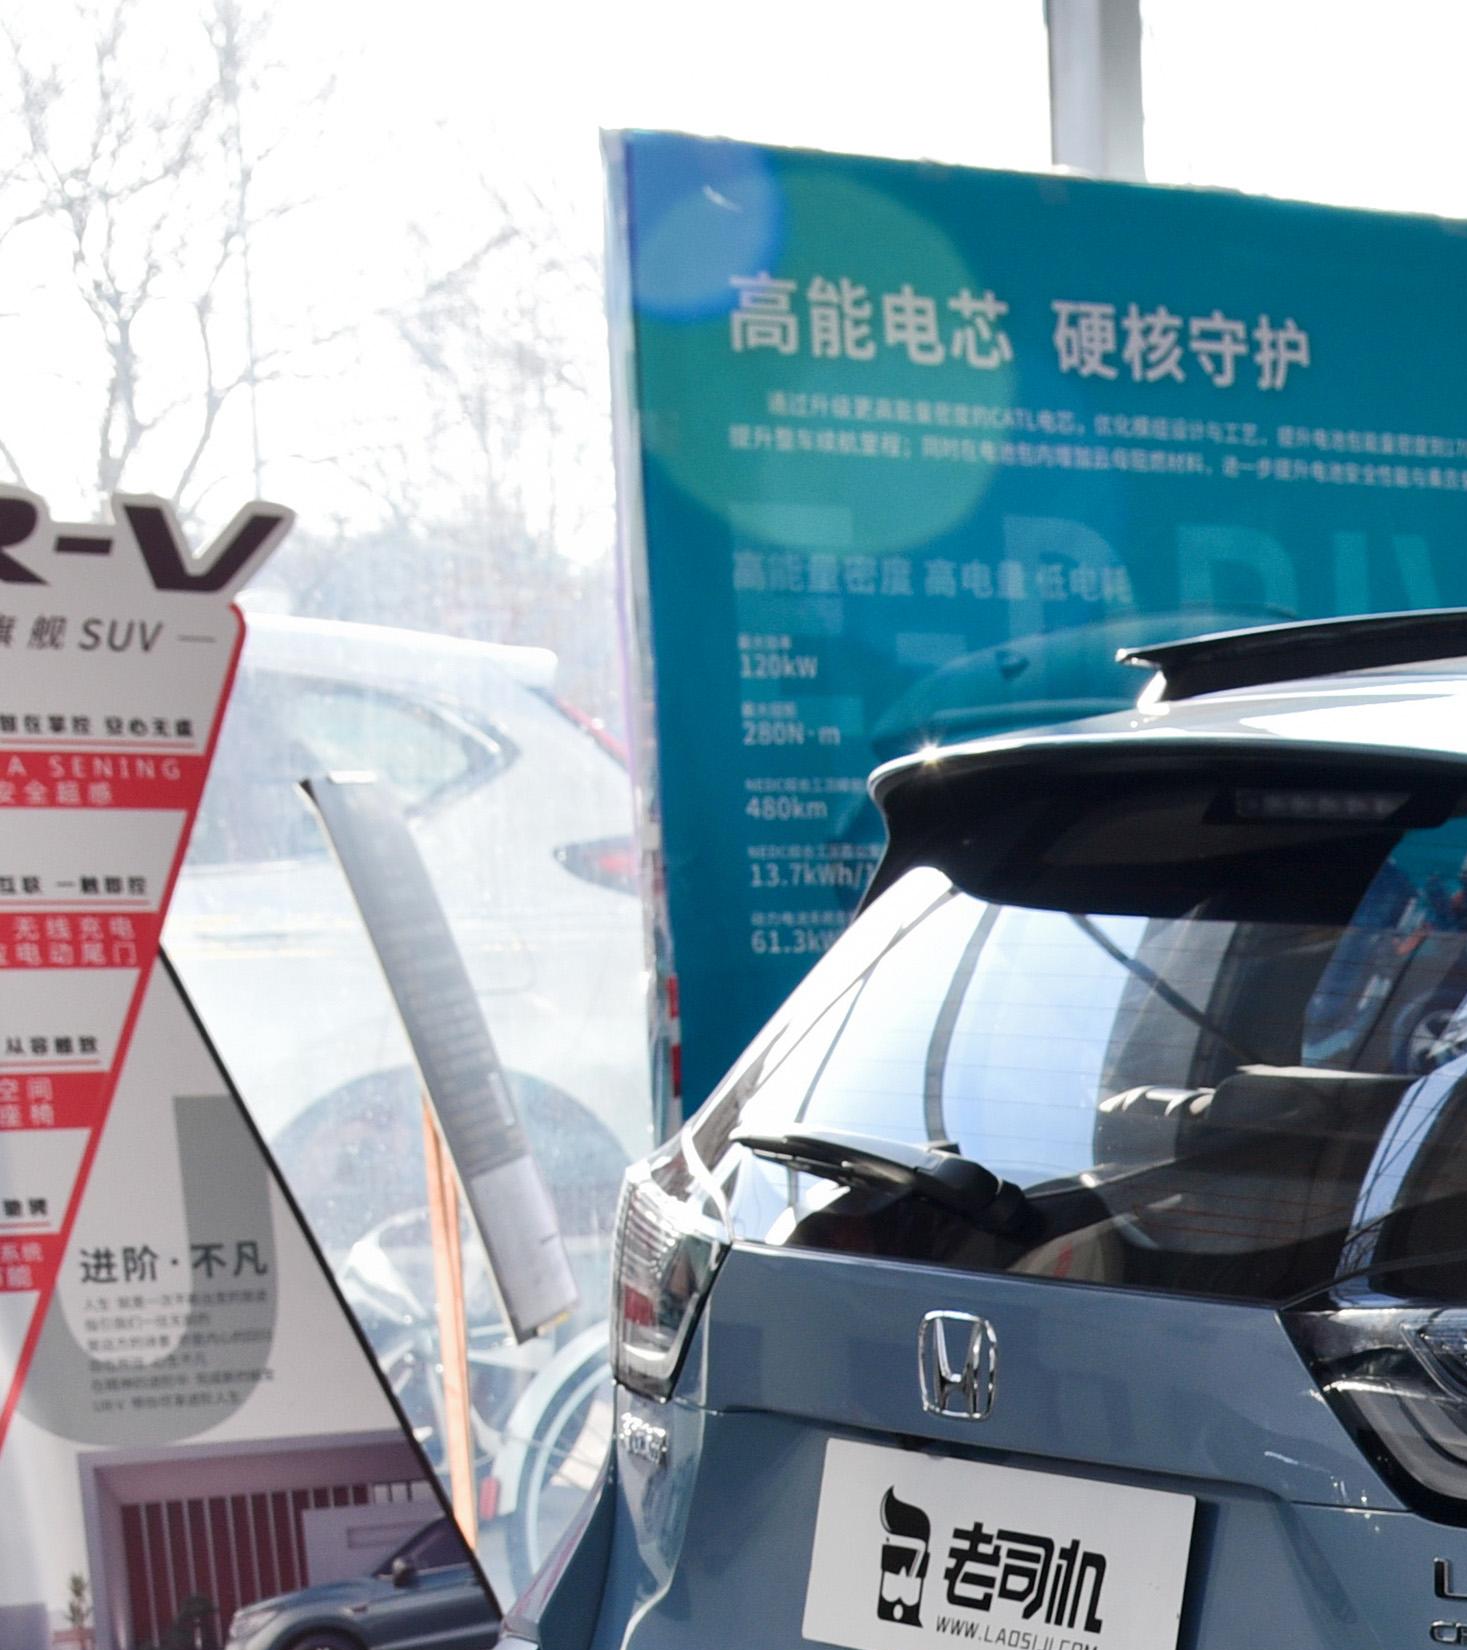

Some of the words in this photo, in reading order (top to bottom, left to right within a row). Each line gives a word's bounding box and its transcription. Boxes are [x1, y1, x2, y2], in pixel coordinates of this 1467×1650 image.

[728, 270, 1014, 372] 高能电芯
[1051, 297, 1311, 391] 硬核守护
[733, 551, 913, 596] 高能量密度
[924, 558, 1026, 600] 高电量
[740, 654, 818, 679] 120kW
[746, 797, 828, 820] 480km
[944, 1521, 1107, 1634] 老司机
